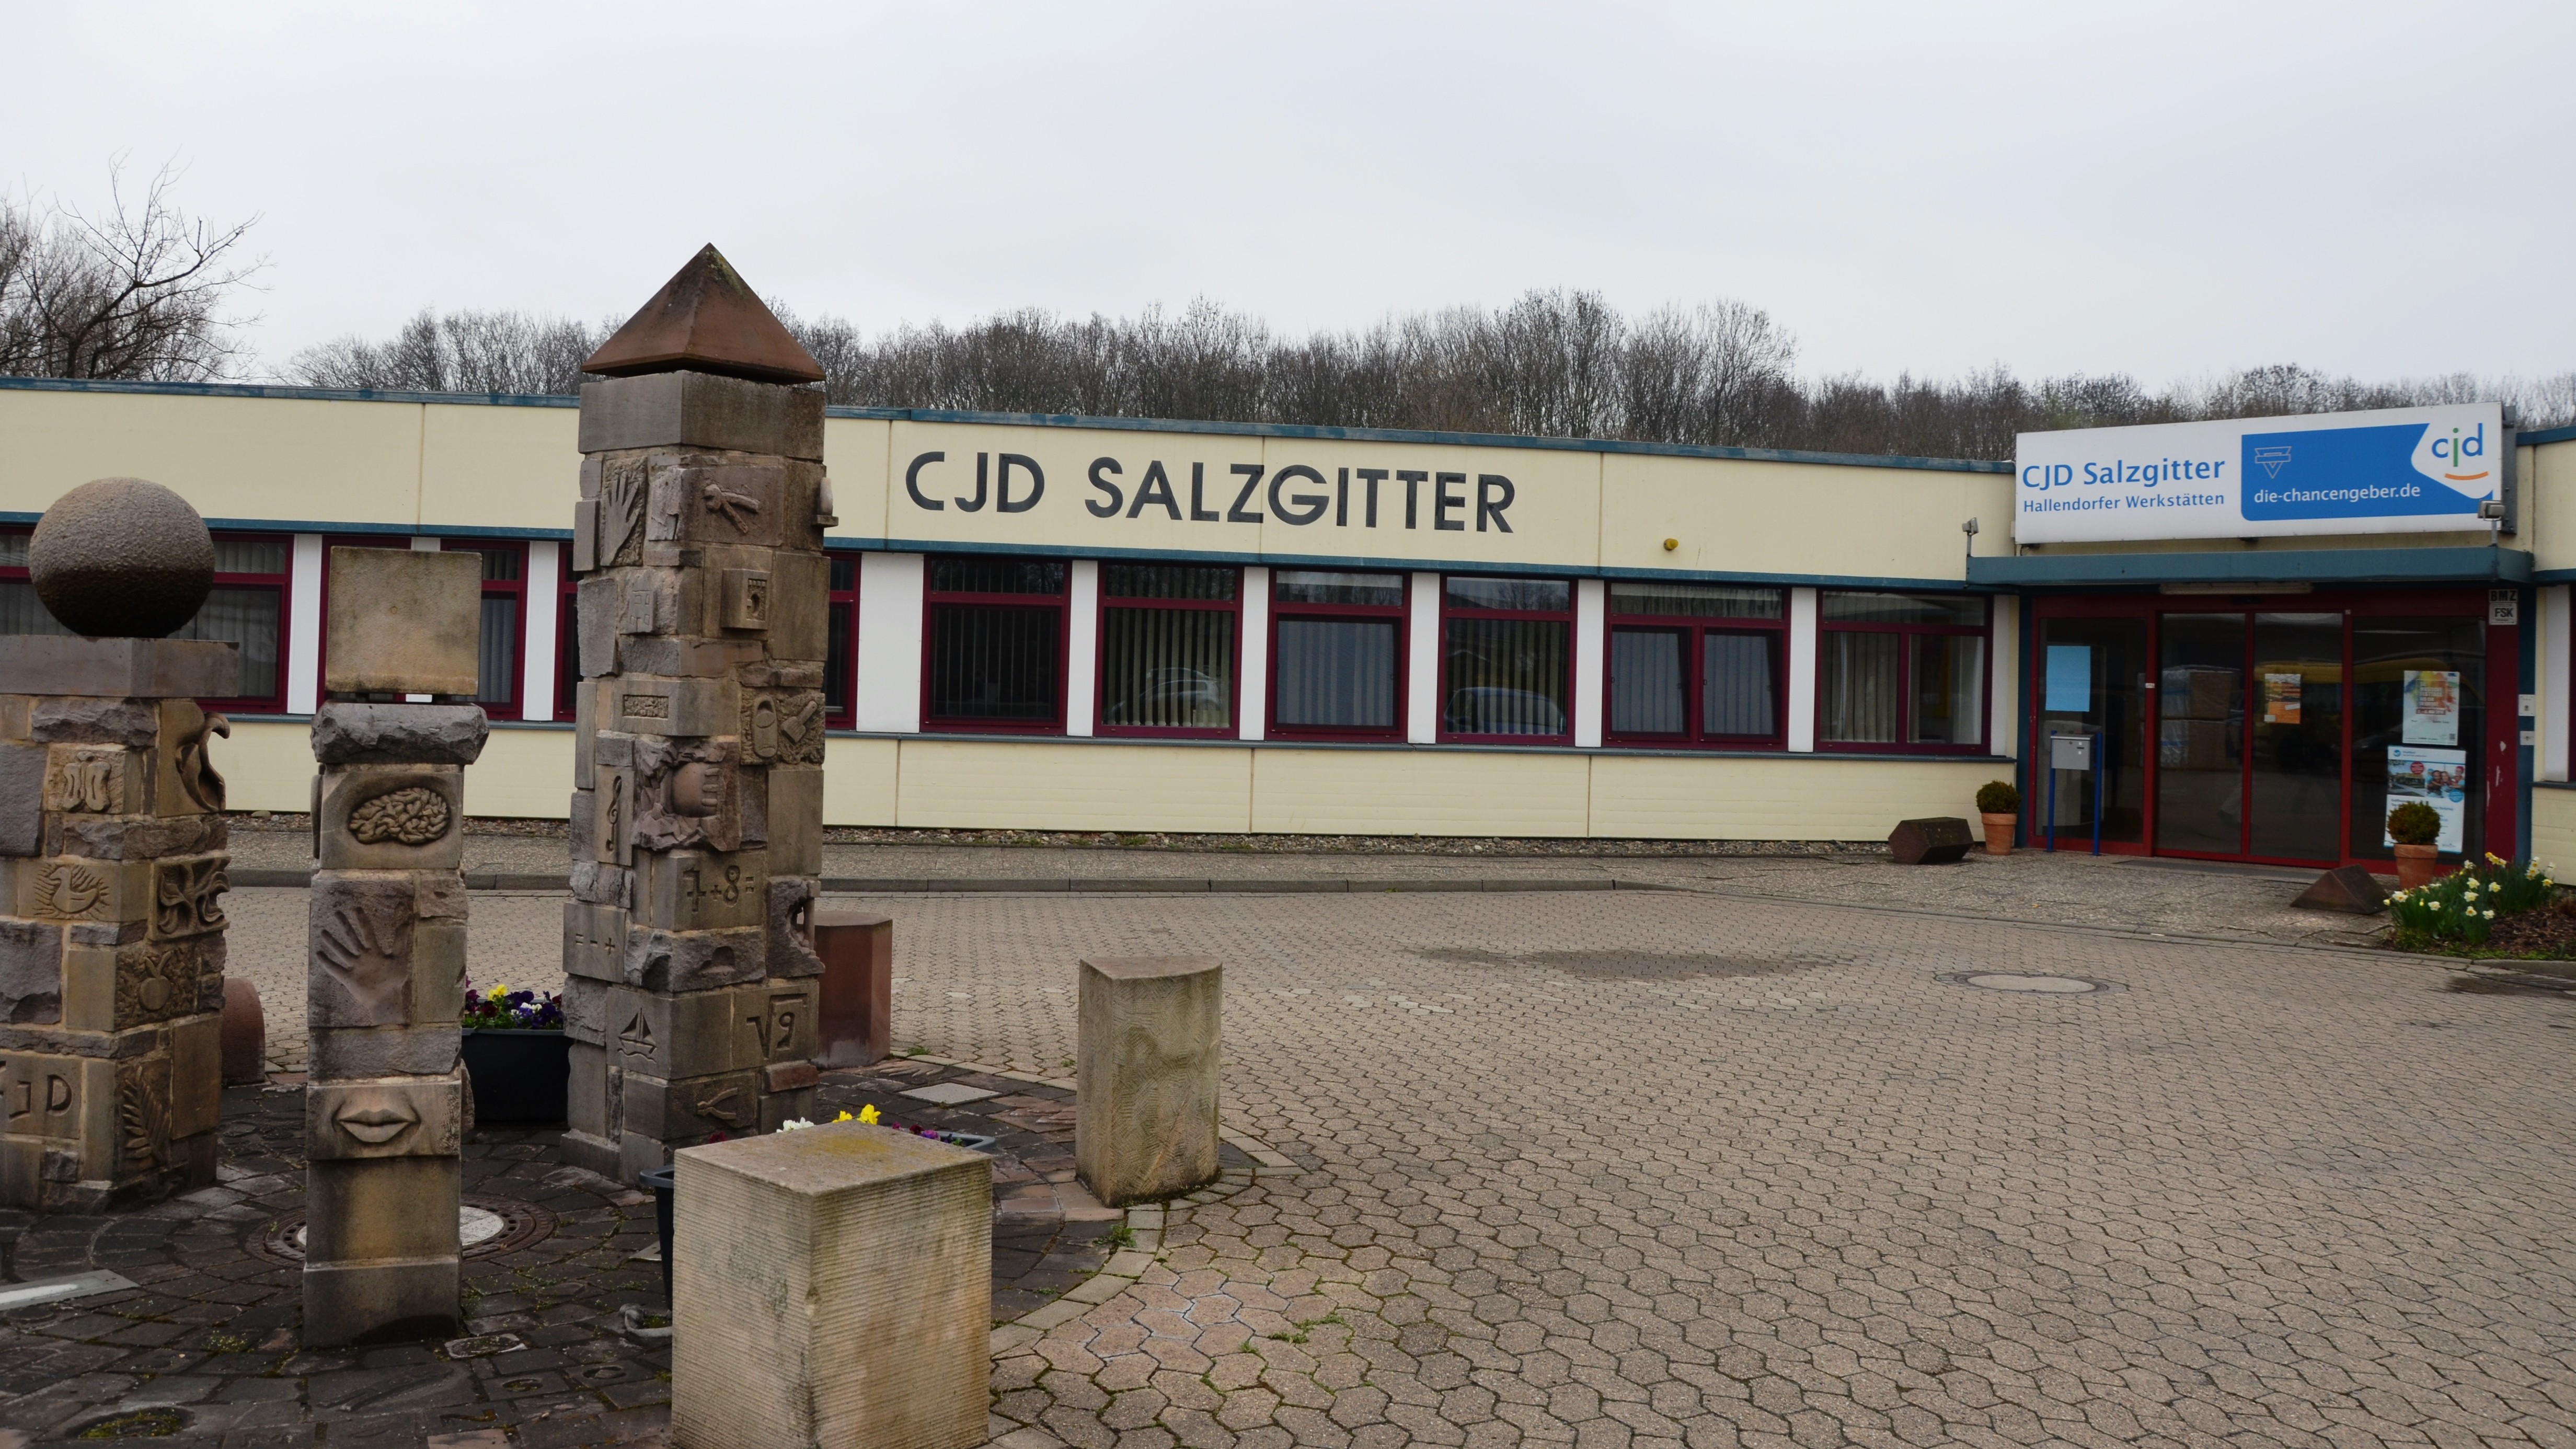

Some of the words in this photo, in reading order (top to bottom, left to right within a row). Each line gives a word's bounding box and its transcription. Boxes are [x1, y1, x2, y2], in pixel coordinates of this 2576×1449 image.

[2432, 423, 2482, 467] cjd
[2022, 464, 2073, 491] CJD
[2084, 458, 2225, 487] Salzgitter
[906, 451, 1045, 513] CJD
[1085, 457, 1515, 533] SALZGITTER
[2254, 483, 2421, 502] die-chancengeber.de
[2023, 496, 2120, 512] Hallendorfer
[2126, 493, 2225, 508] Werkstätten
[2491, 590, 2516, 601] BMZ
[2494, 608, 2513, 617] FSK
